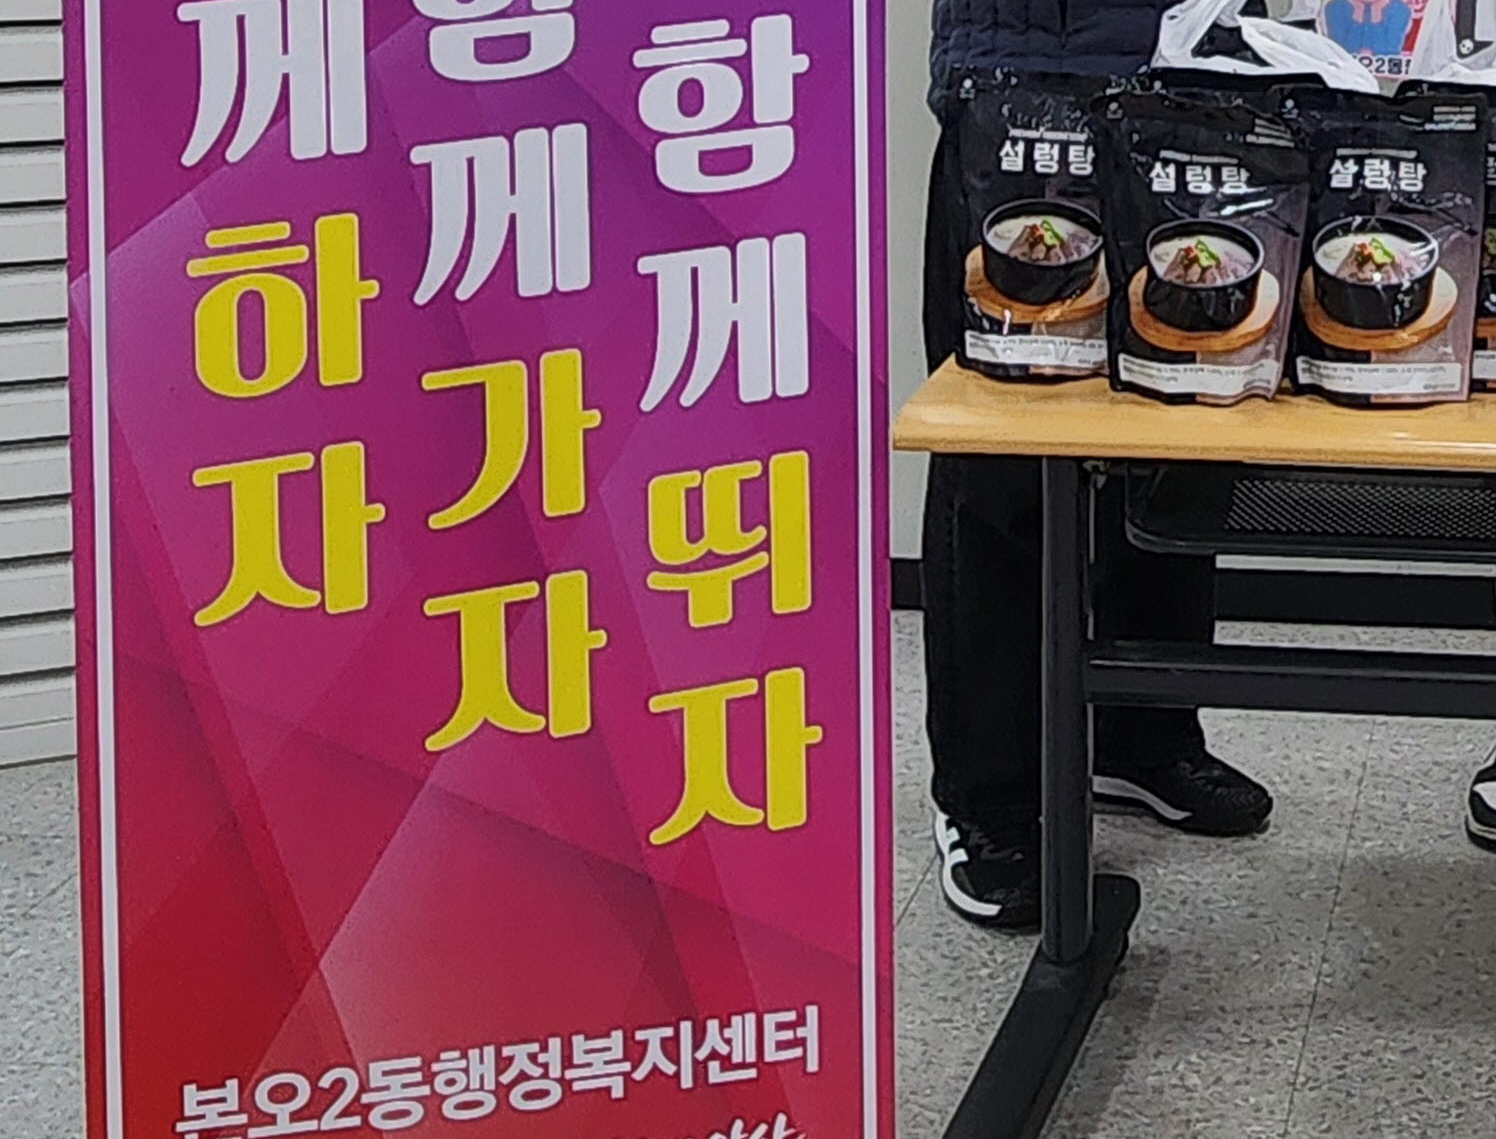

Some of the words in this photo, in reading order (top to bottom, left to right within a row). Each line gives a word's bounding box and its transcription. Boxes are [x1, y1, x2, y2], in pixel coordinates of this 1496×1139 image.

[999, 139, 1096, 176] 설렁탕
[1329, 158, 1427, 192] 설렁탕
[1149, 161, 1251, 194] 설렁탕
[174, 1005, 820, 1139] 본오2동행정복지센터
